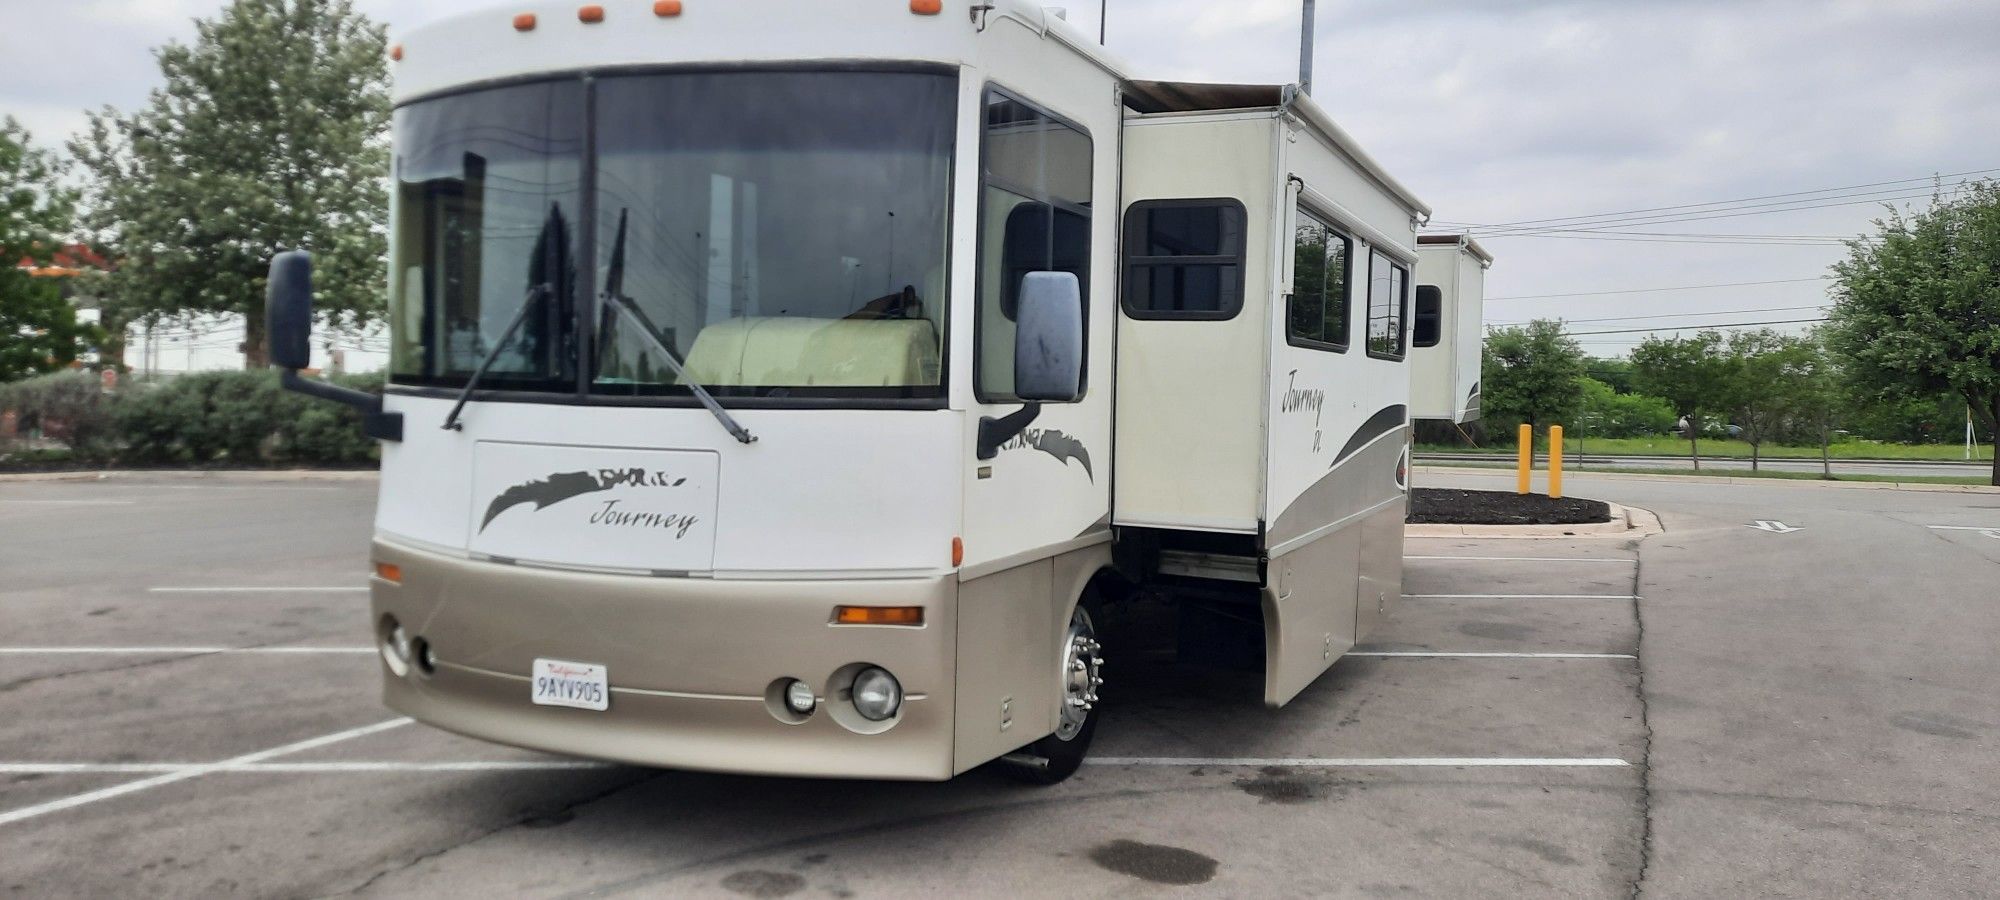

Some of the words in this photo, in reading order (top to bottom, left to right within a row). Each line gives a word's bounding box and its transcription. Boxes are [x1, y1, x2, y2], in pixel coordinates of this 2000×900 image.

[1282, 369, 1325, 428] Journey
[589, 499, 698, 539] Journey
[538, 677, 602, 703] 9AYV905
